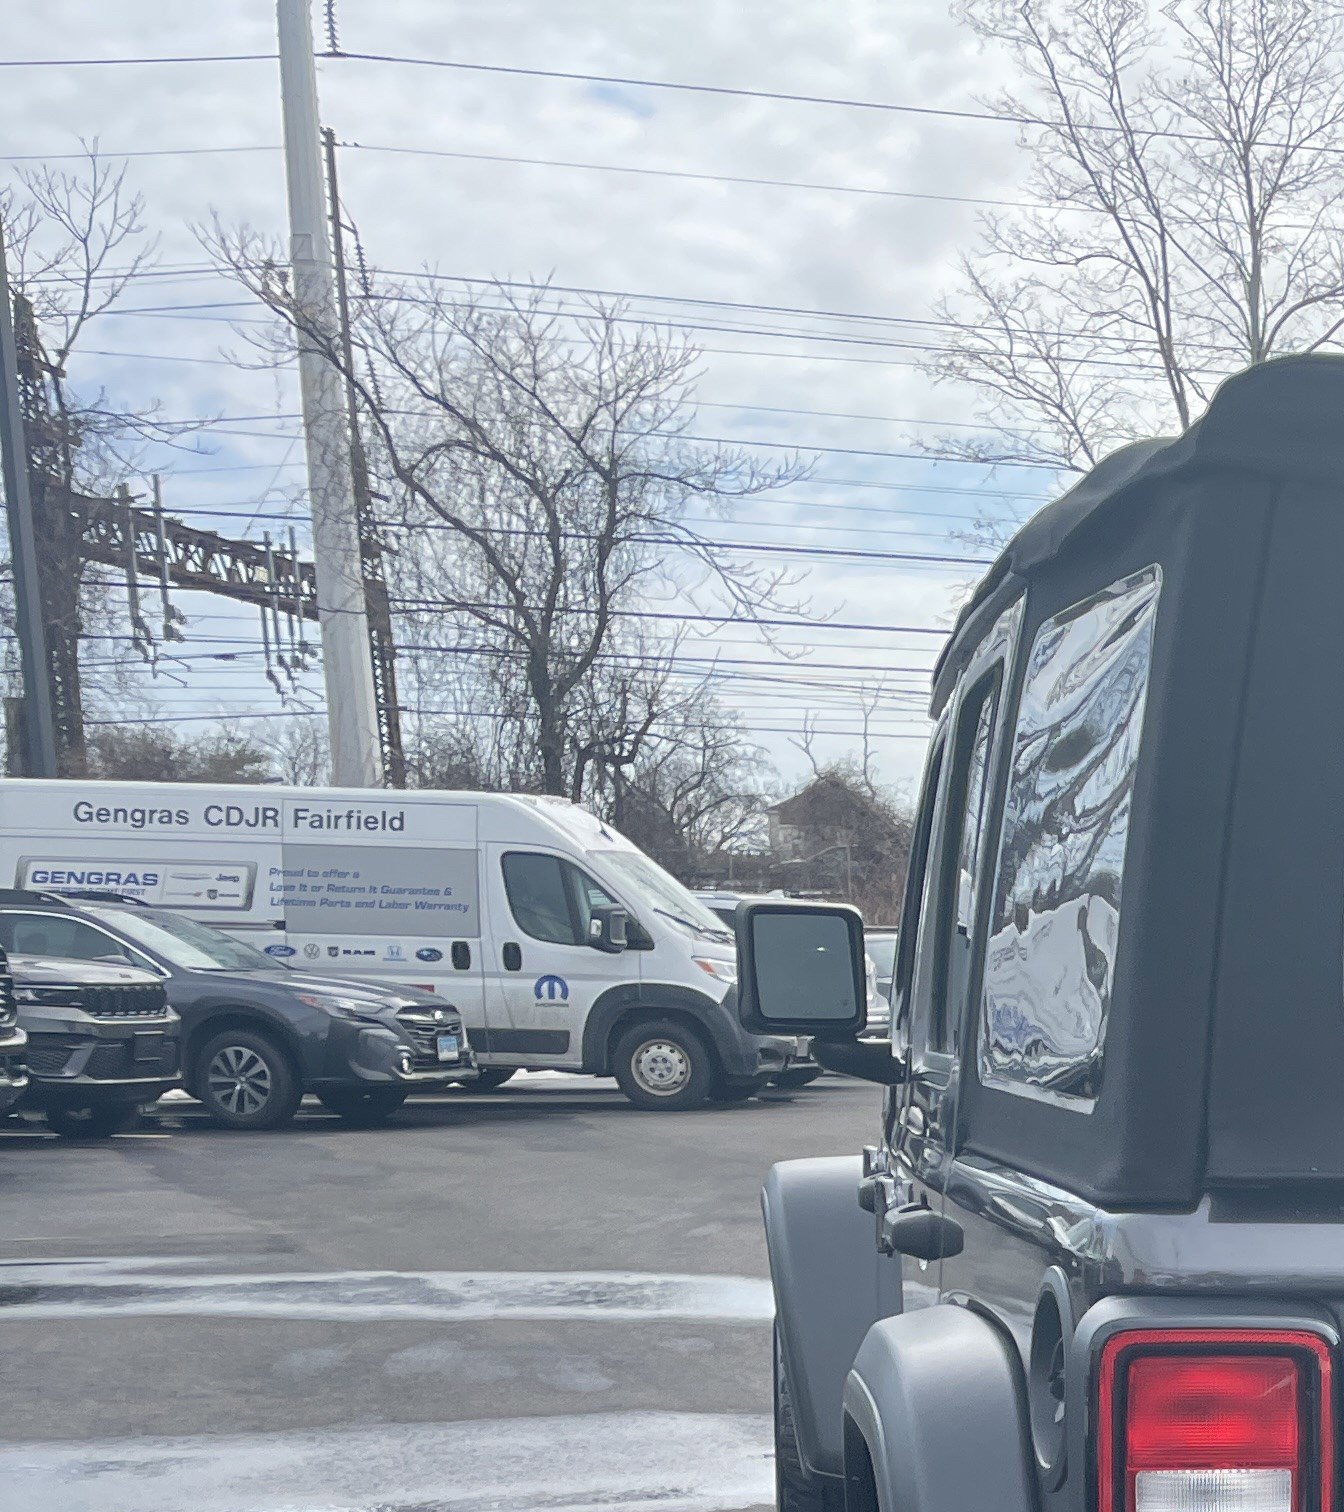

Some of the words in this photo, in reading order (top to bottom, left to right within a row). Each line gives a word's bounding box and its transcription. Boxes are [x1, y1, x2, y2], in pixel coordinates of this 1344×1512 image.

[73, 801, 190, 828] Gengras
[203, 805, 280, 828] CDJR
[293, 807, 406, 832] Fairfield
[31, 870, 158, 887] GENGRAS
[307, 869, 320, 878] to
[322, 868, 351, 879] offer
[326, 883, 366, 894] Return
[380, 885, 441, 896] Guarantee
[414, 900, 470, 914] Warranty
